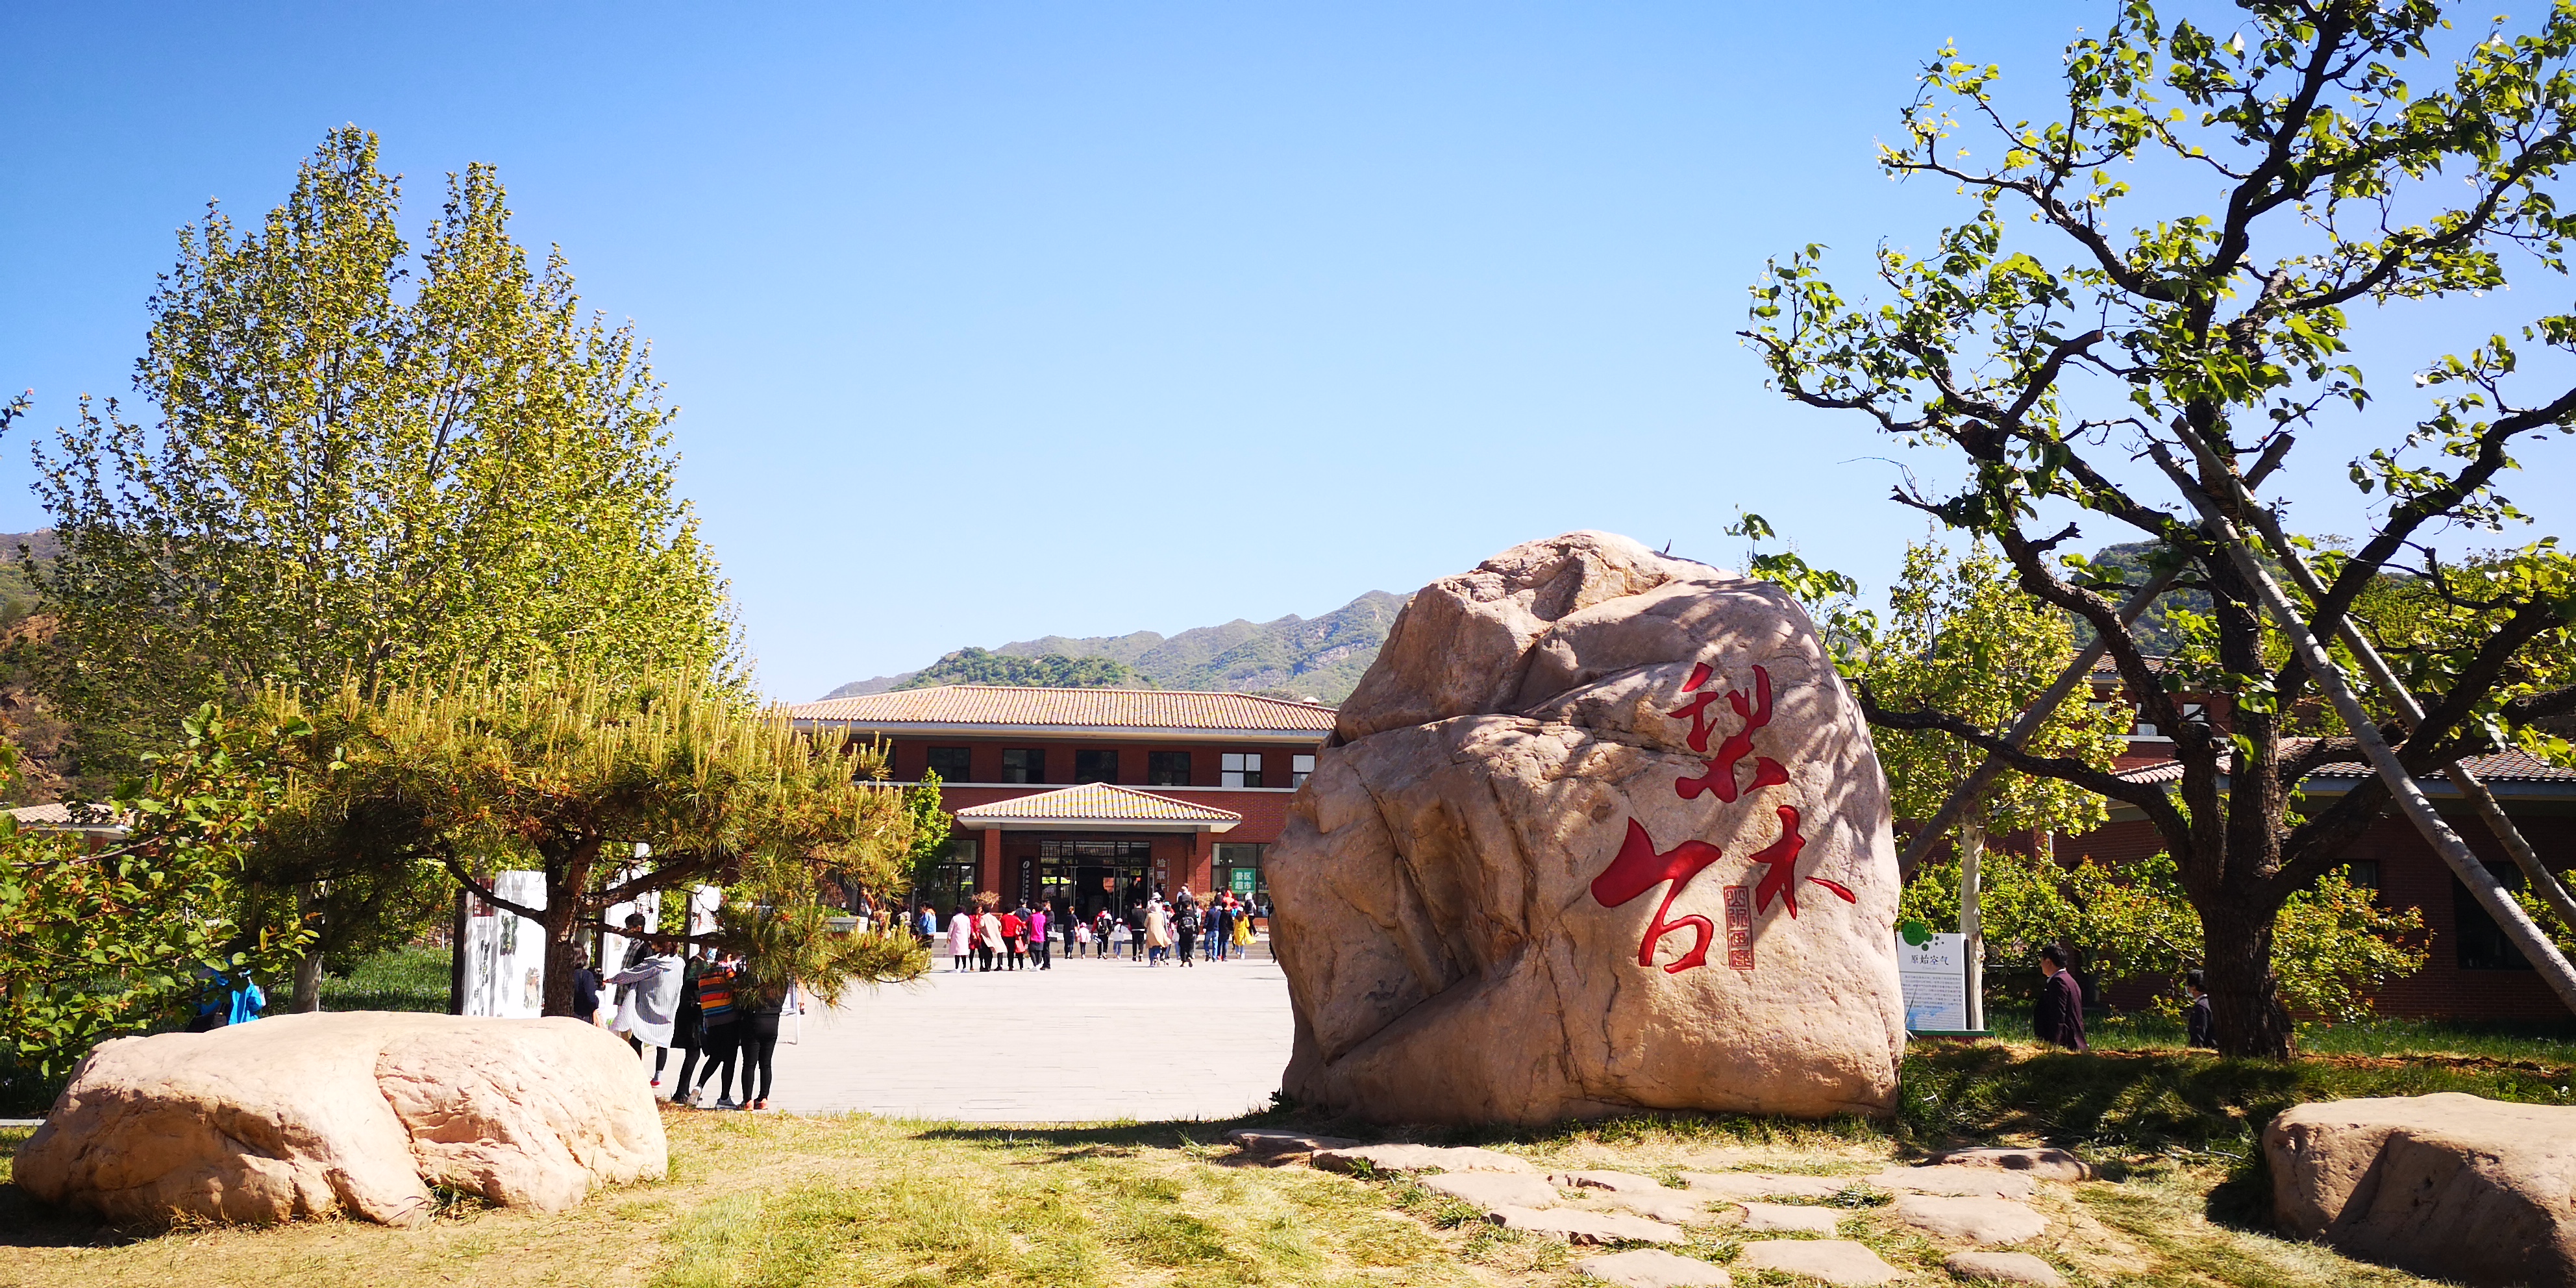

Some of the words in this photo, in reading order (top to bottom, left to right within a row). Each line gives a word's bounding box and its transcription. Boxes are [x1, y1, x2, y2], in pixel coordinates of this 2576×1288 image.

[1235, 872, 1251, 880] 景区
[1235, 881, 1251, 889] 超市
[1911, 954, 1950, 966] 原始空气
